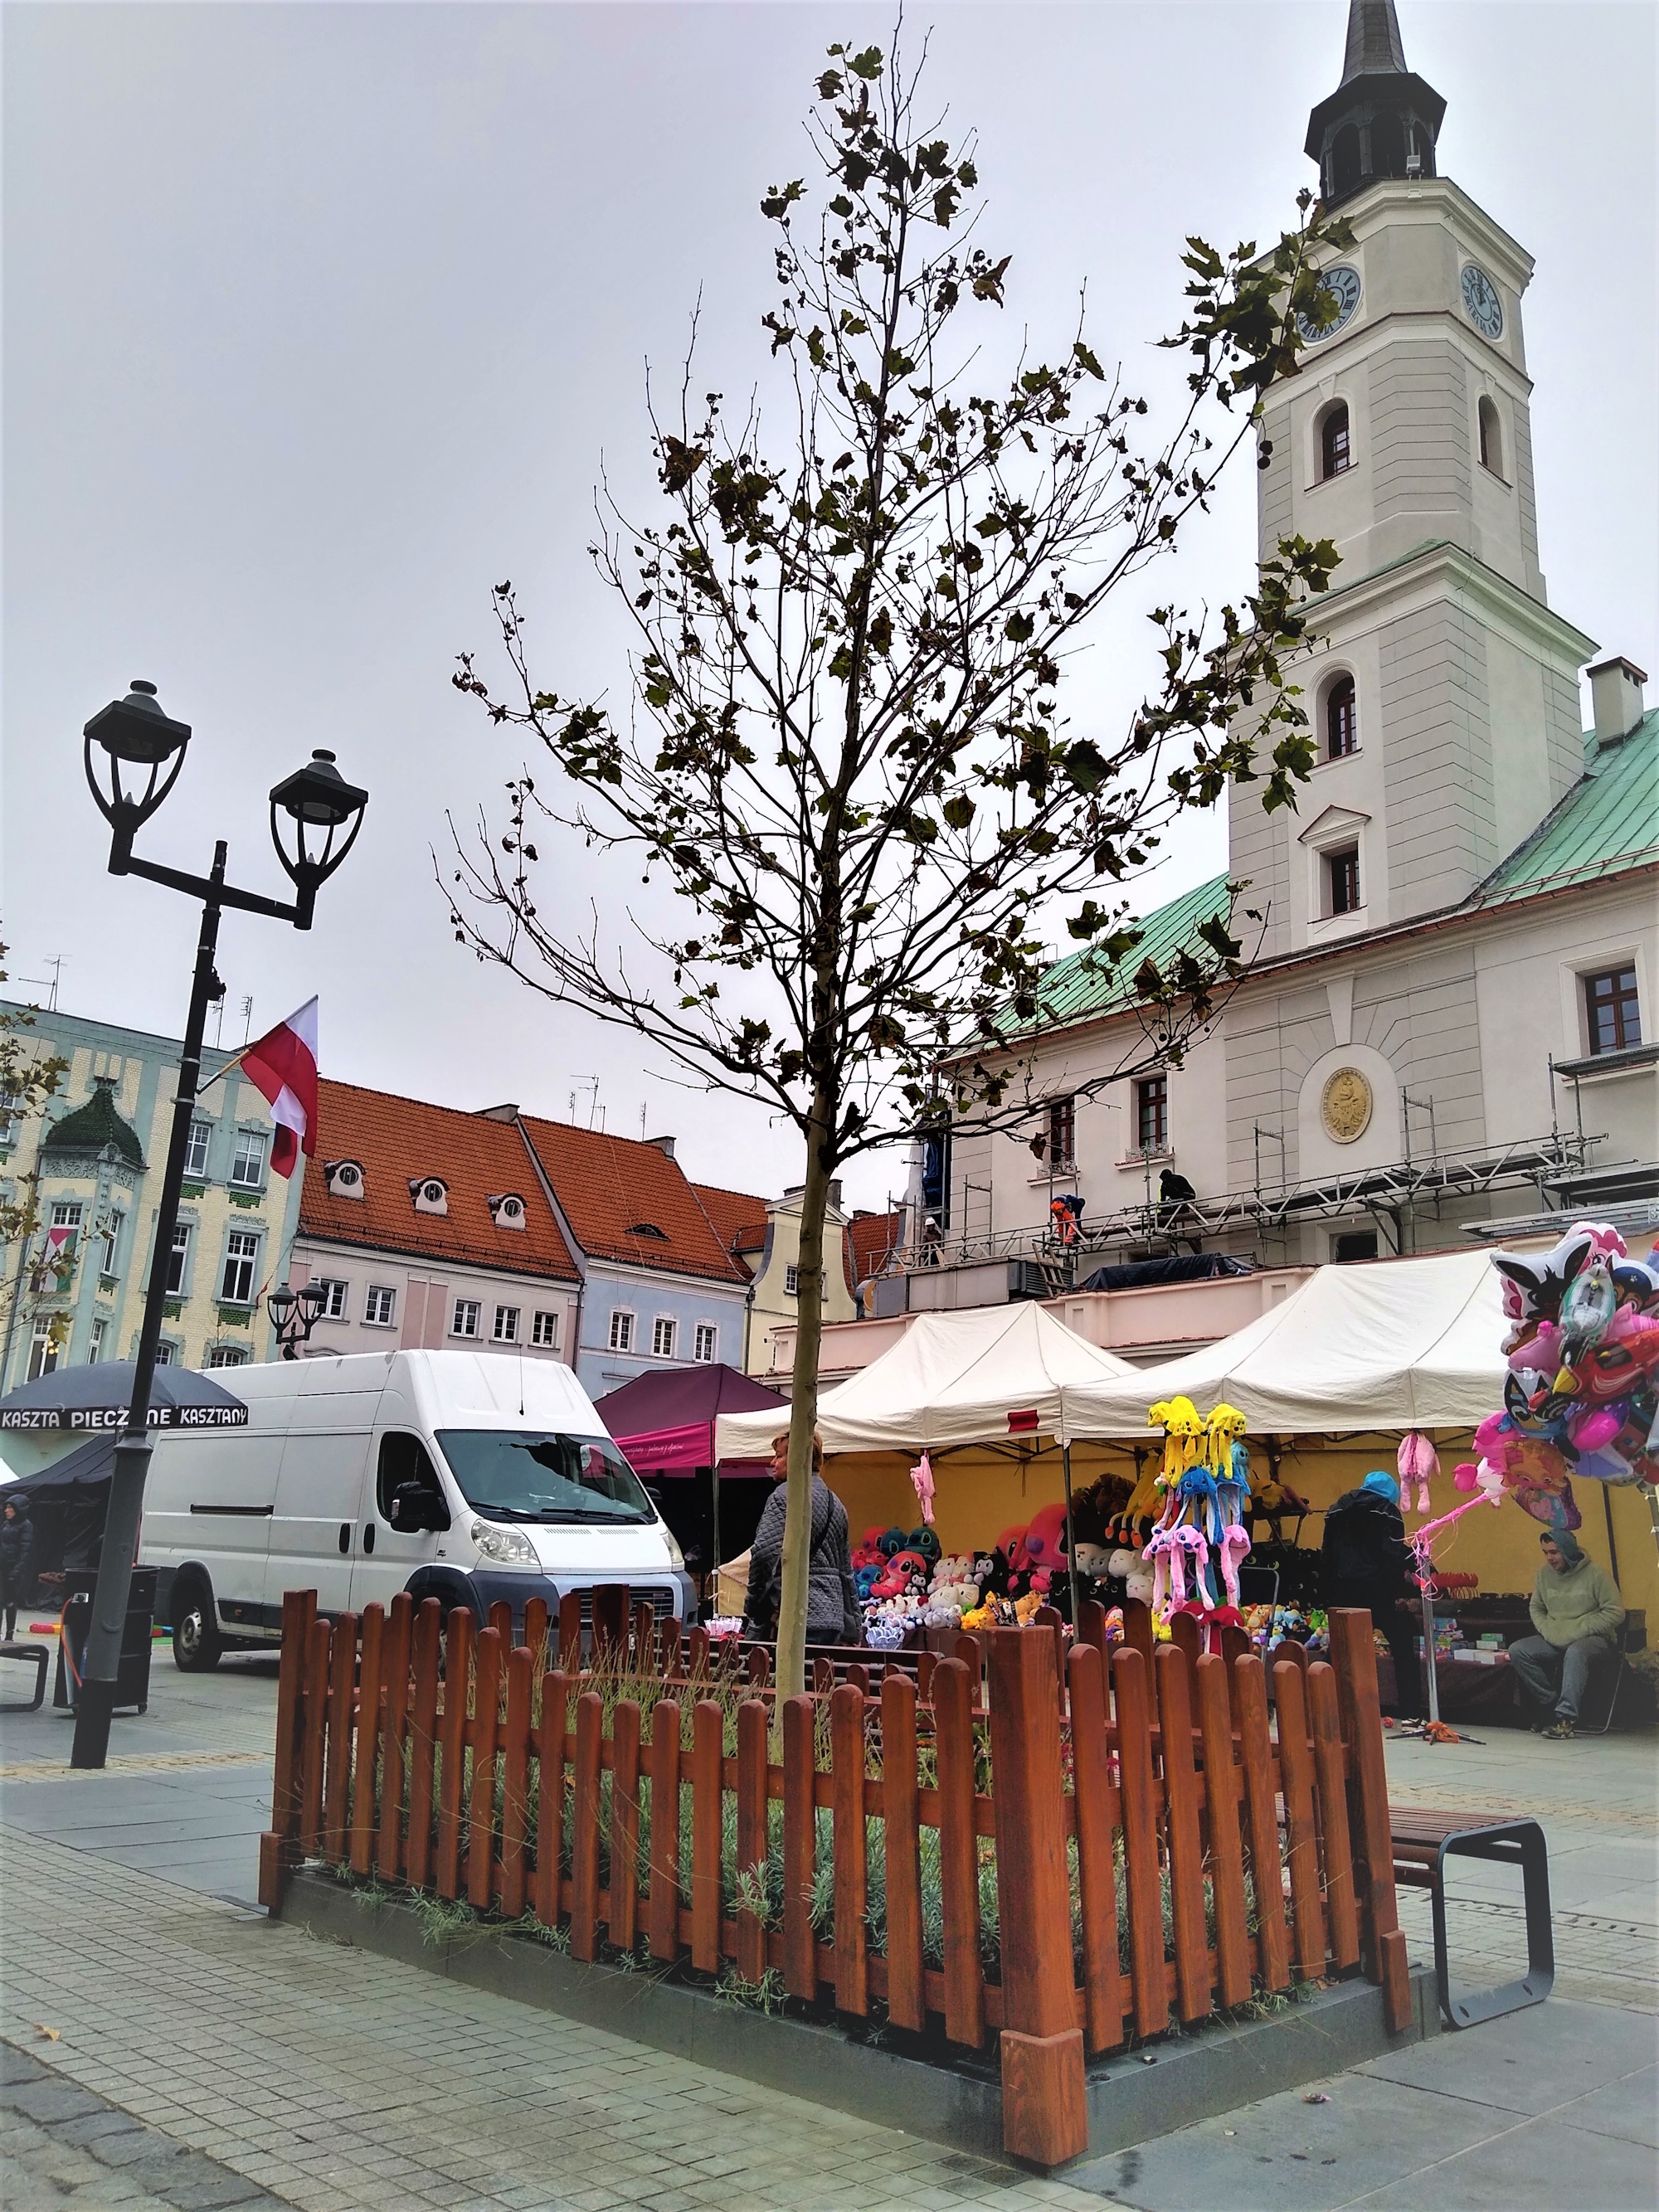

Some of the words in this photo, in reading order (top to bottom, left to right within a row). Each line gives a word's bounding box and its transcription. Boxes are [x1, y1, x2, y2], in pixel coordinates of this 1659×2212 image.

[2, 1411, 61, 1428] KASZTA
[71, 1408, 173, 1428] PIECZNE
[179, 1407, 248, 1425] KASZTANY
